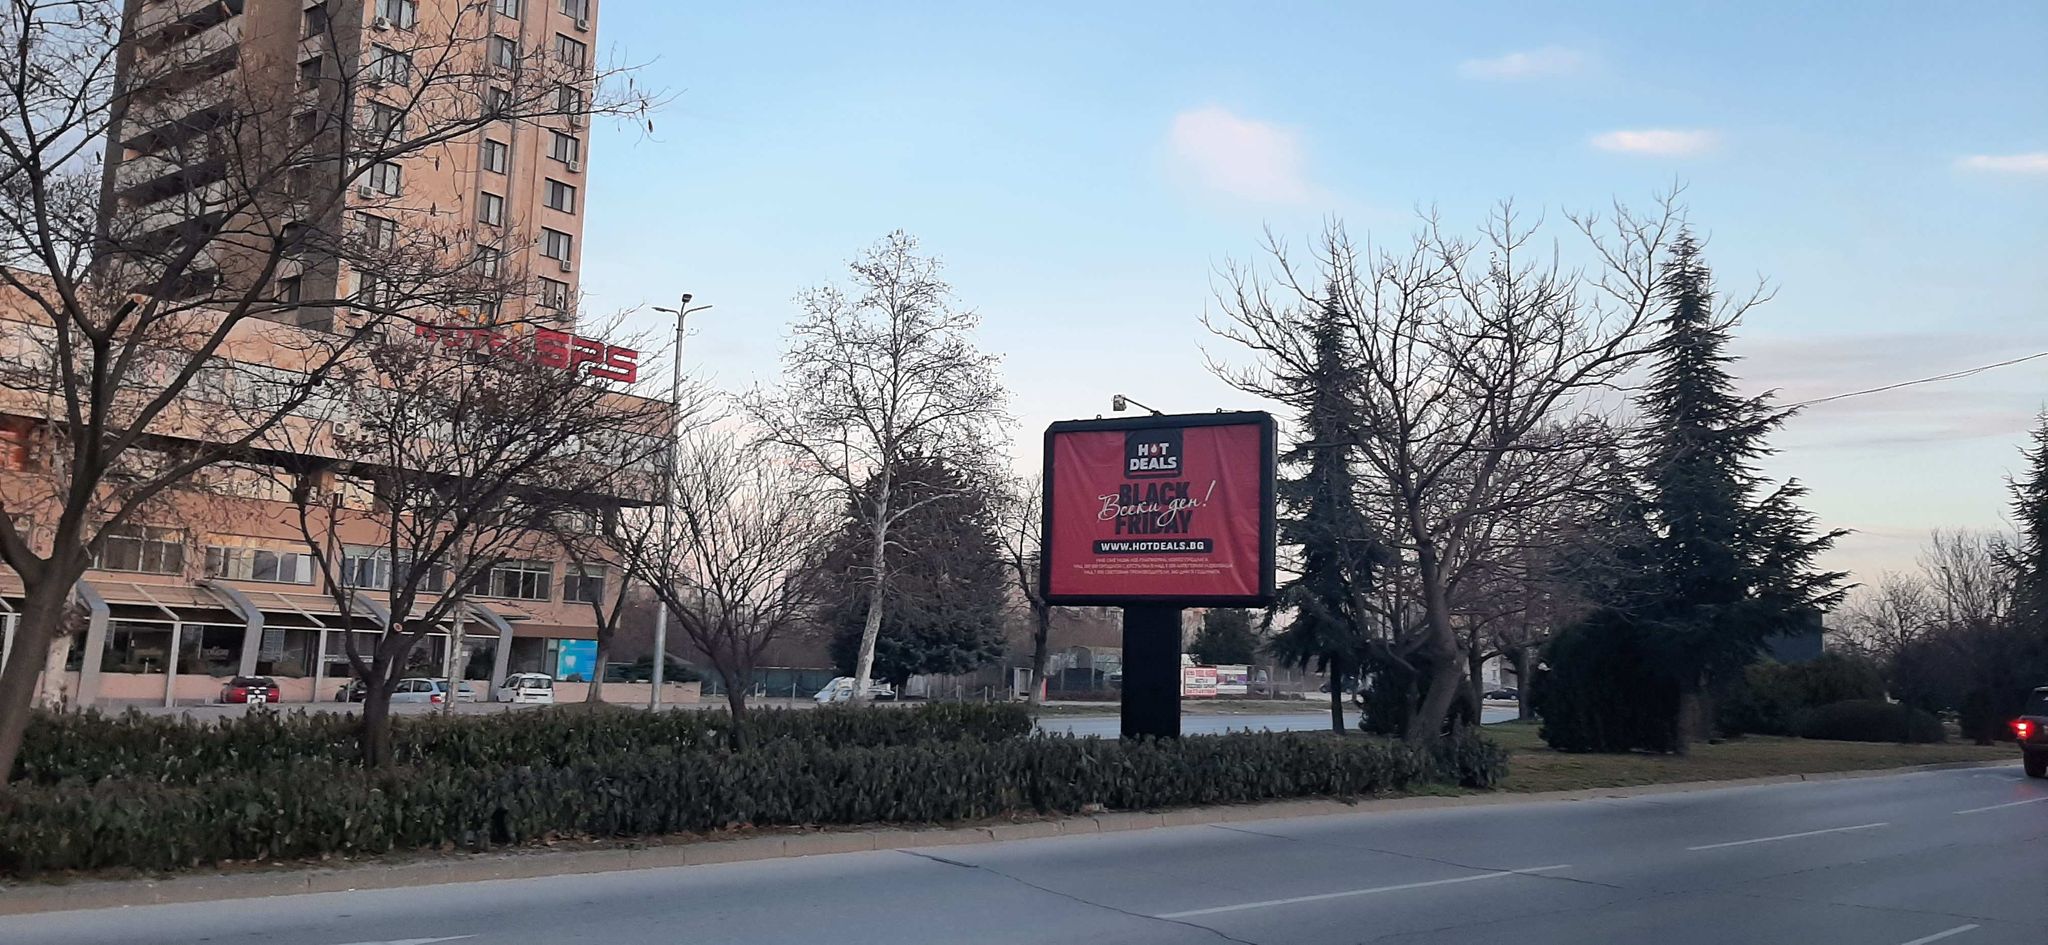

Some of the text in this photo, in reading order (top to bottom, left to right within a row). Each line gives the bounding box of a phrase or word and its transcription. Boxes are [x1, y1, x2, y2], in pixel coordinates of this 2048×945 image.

[1138, 443, 1169, 456] HOT
[1130, 457, 1177, 471] DEALS
[1097, 480, 1216, 527] Всеки ден!
[1119, 482, 1190, 507] BLACK
[1115, 510, 1193, 535] FRIDAY
[1101, 541, 1204, 551] WWW.HOTDEALS.BG
